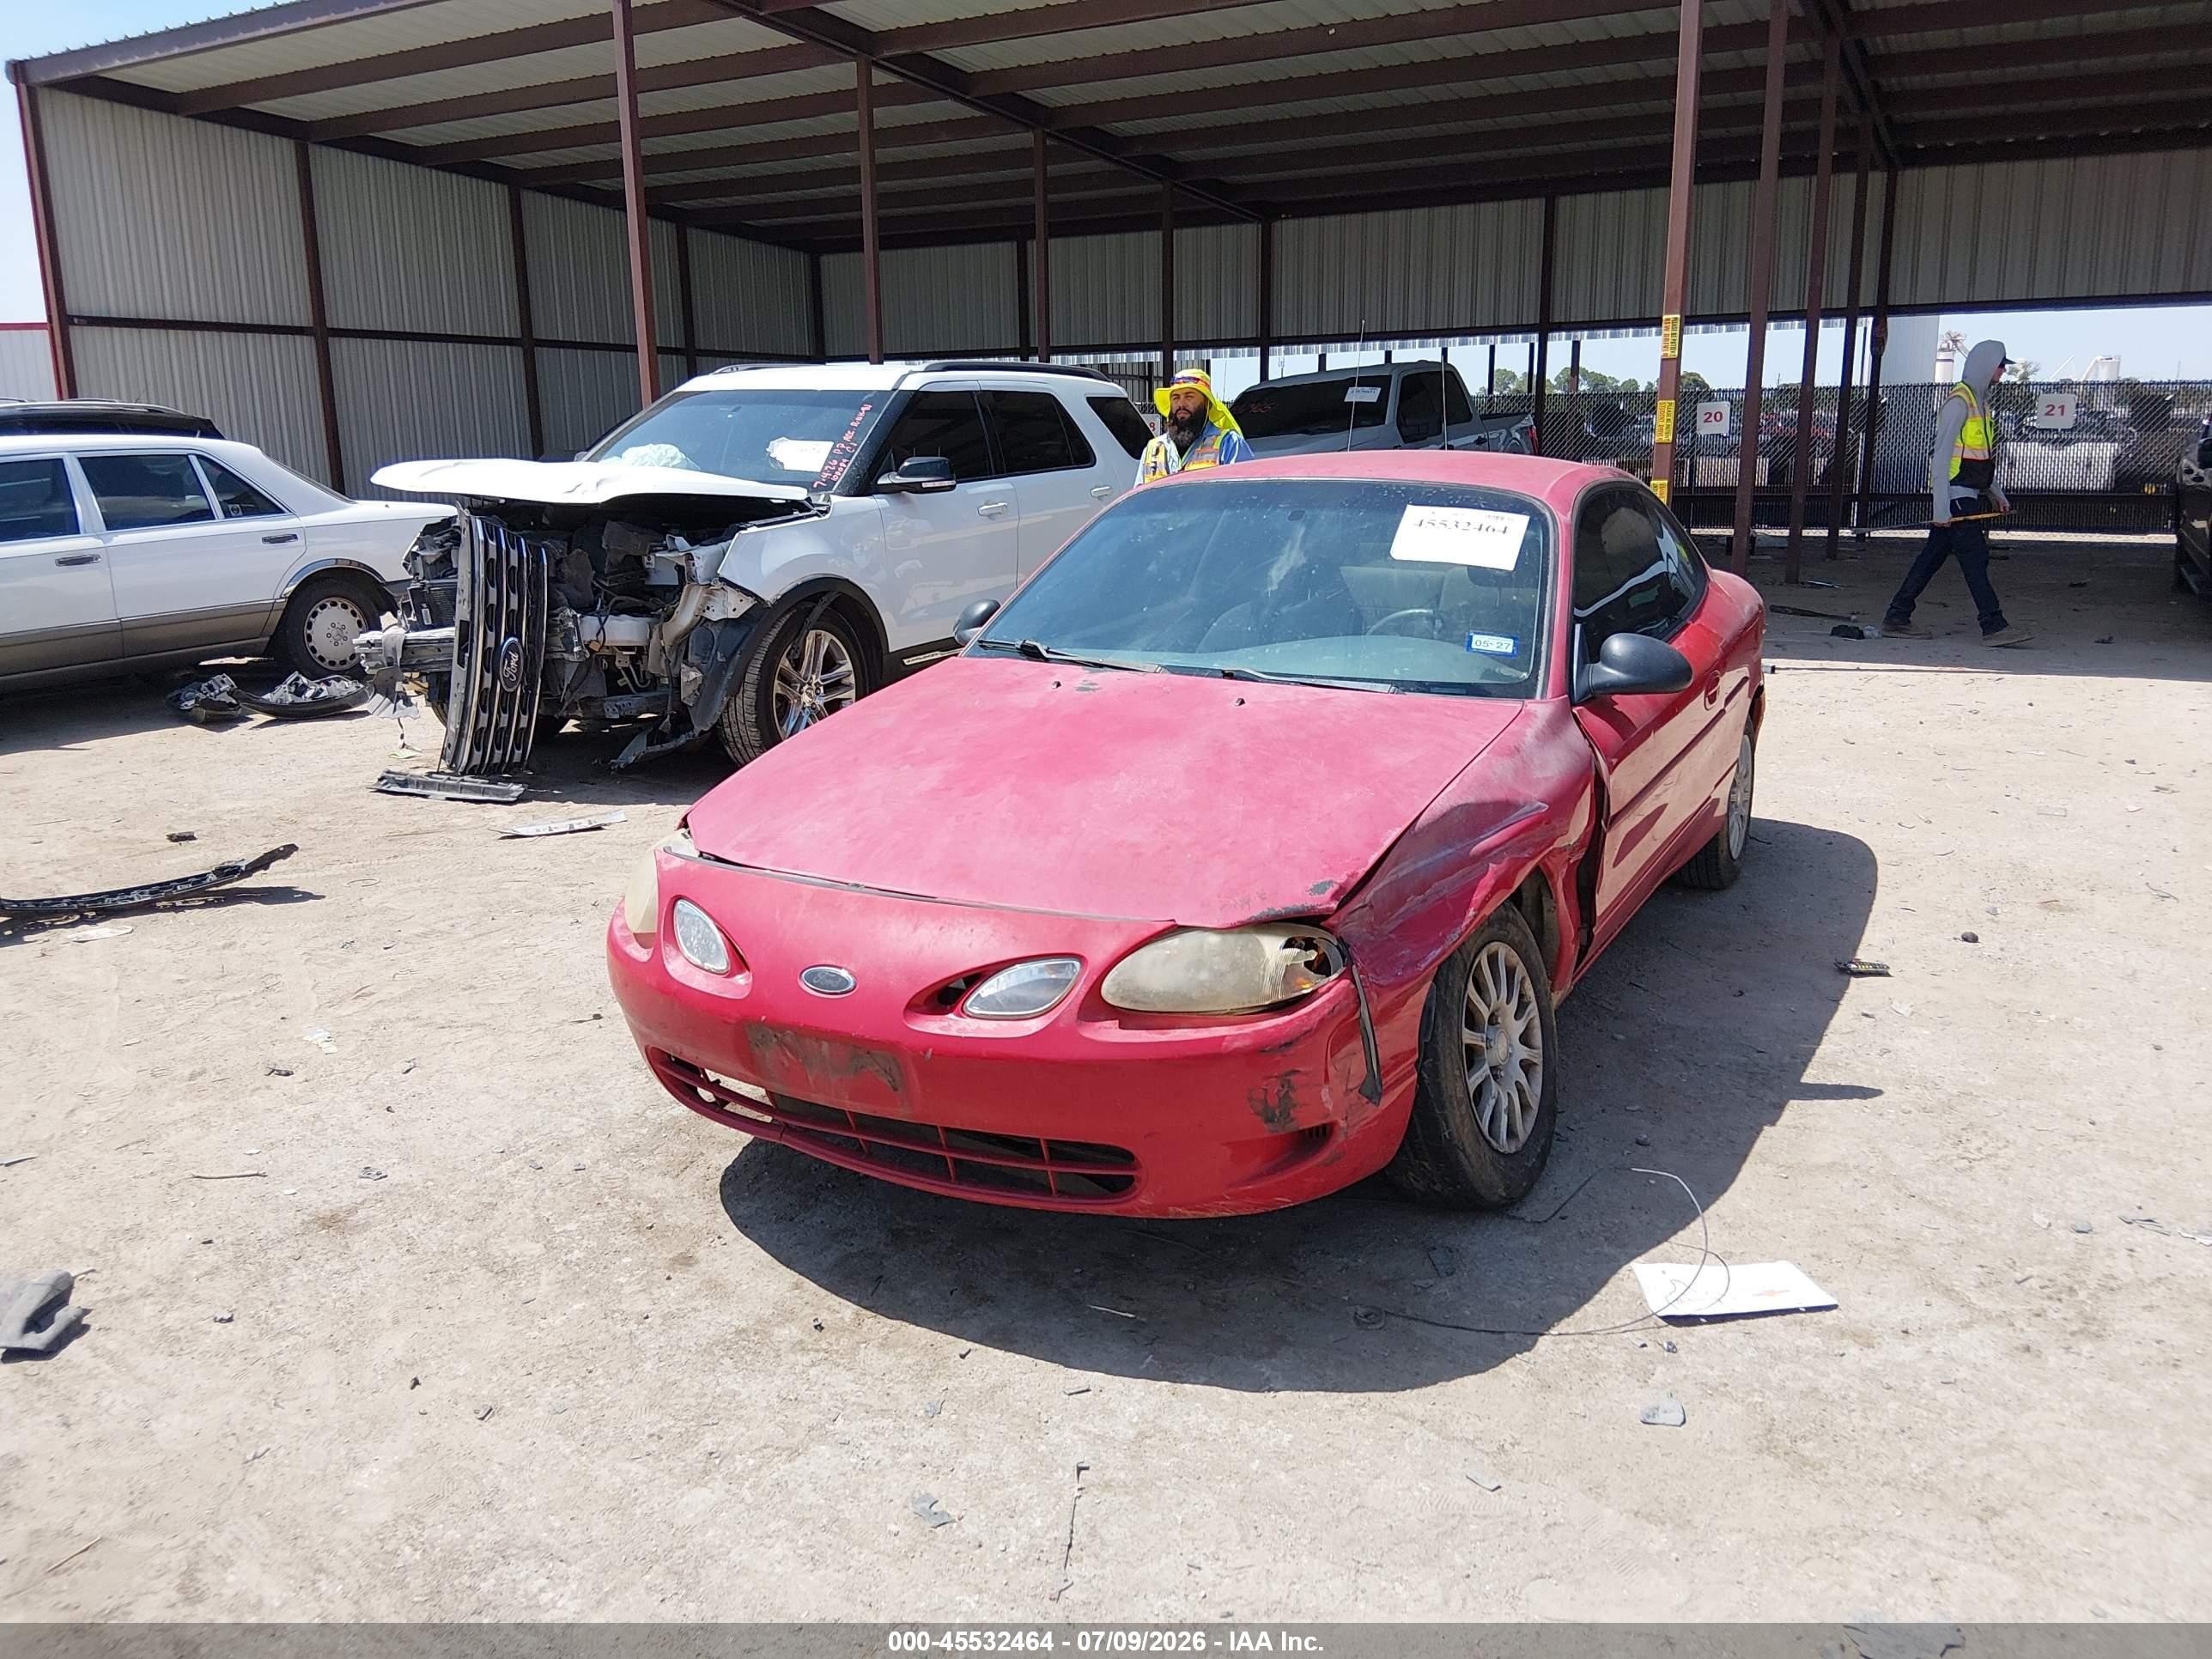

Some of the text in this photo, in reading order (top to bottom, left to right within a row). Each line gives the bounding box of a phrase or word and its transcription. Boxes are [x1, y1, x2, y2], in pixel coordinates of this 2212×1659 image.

[1703, 411, 1723, 422] 20
[2045, 404, 2065, 416] 21
[1415, 519, 1508, 535] 45532464
[503, 651, 519, 681] Ford
